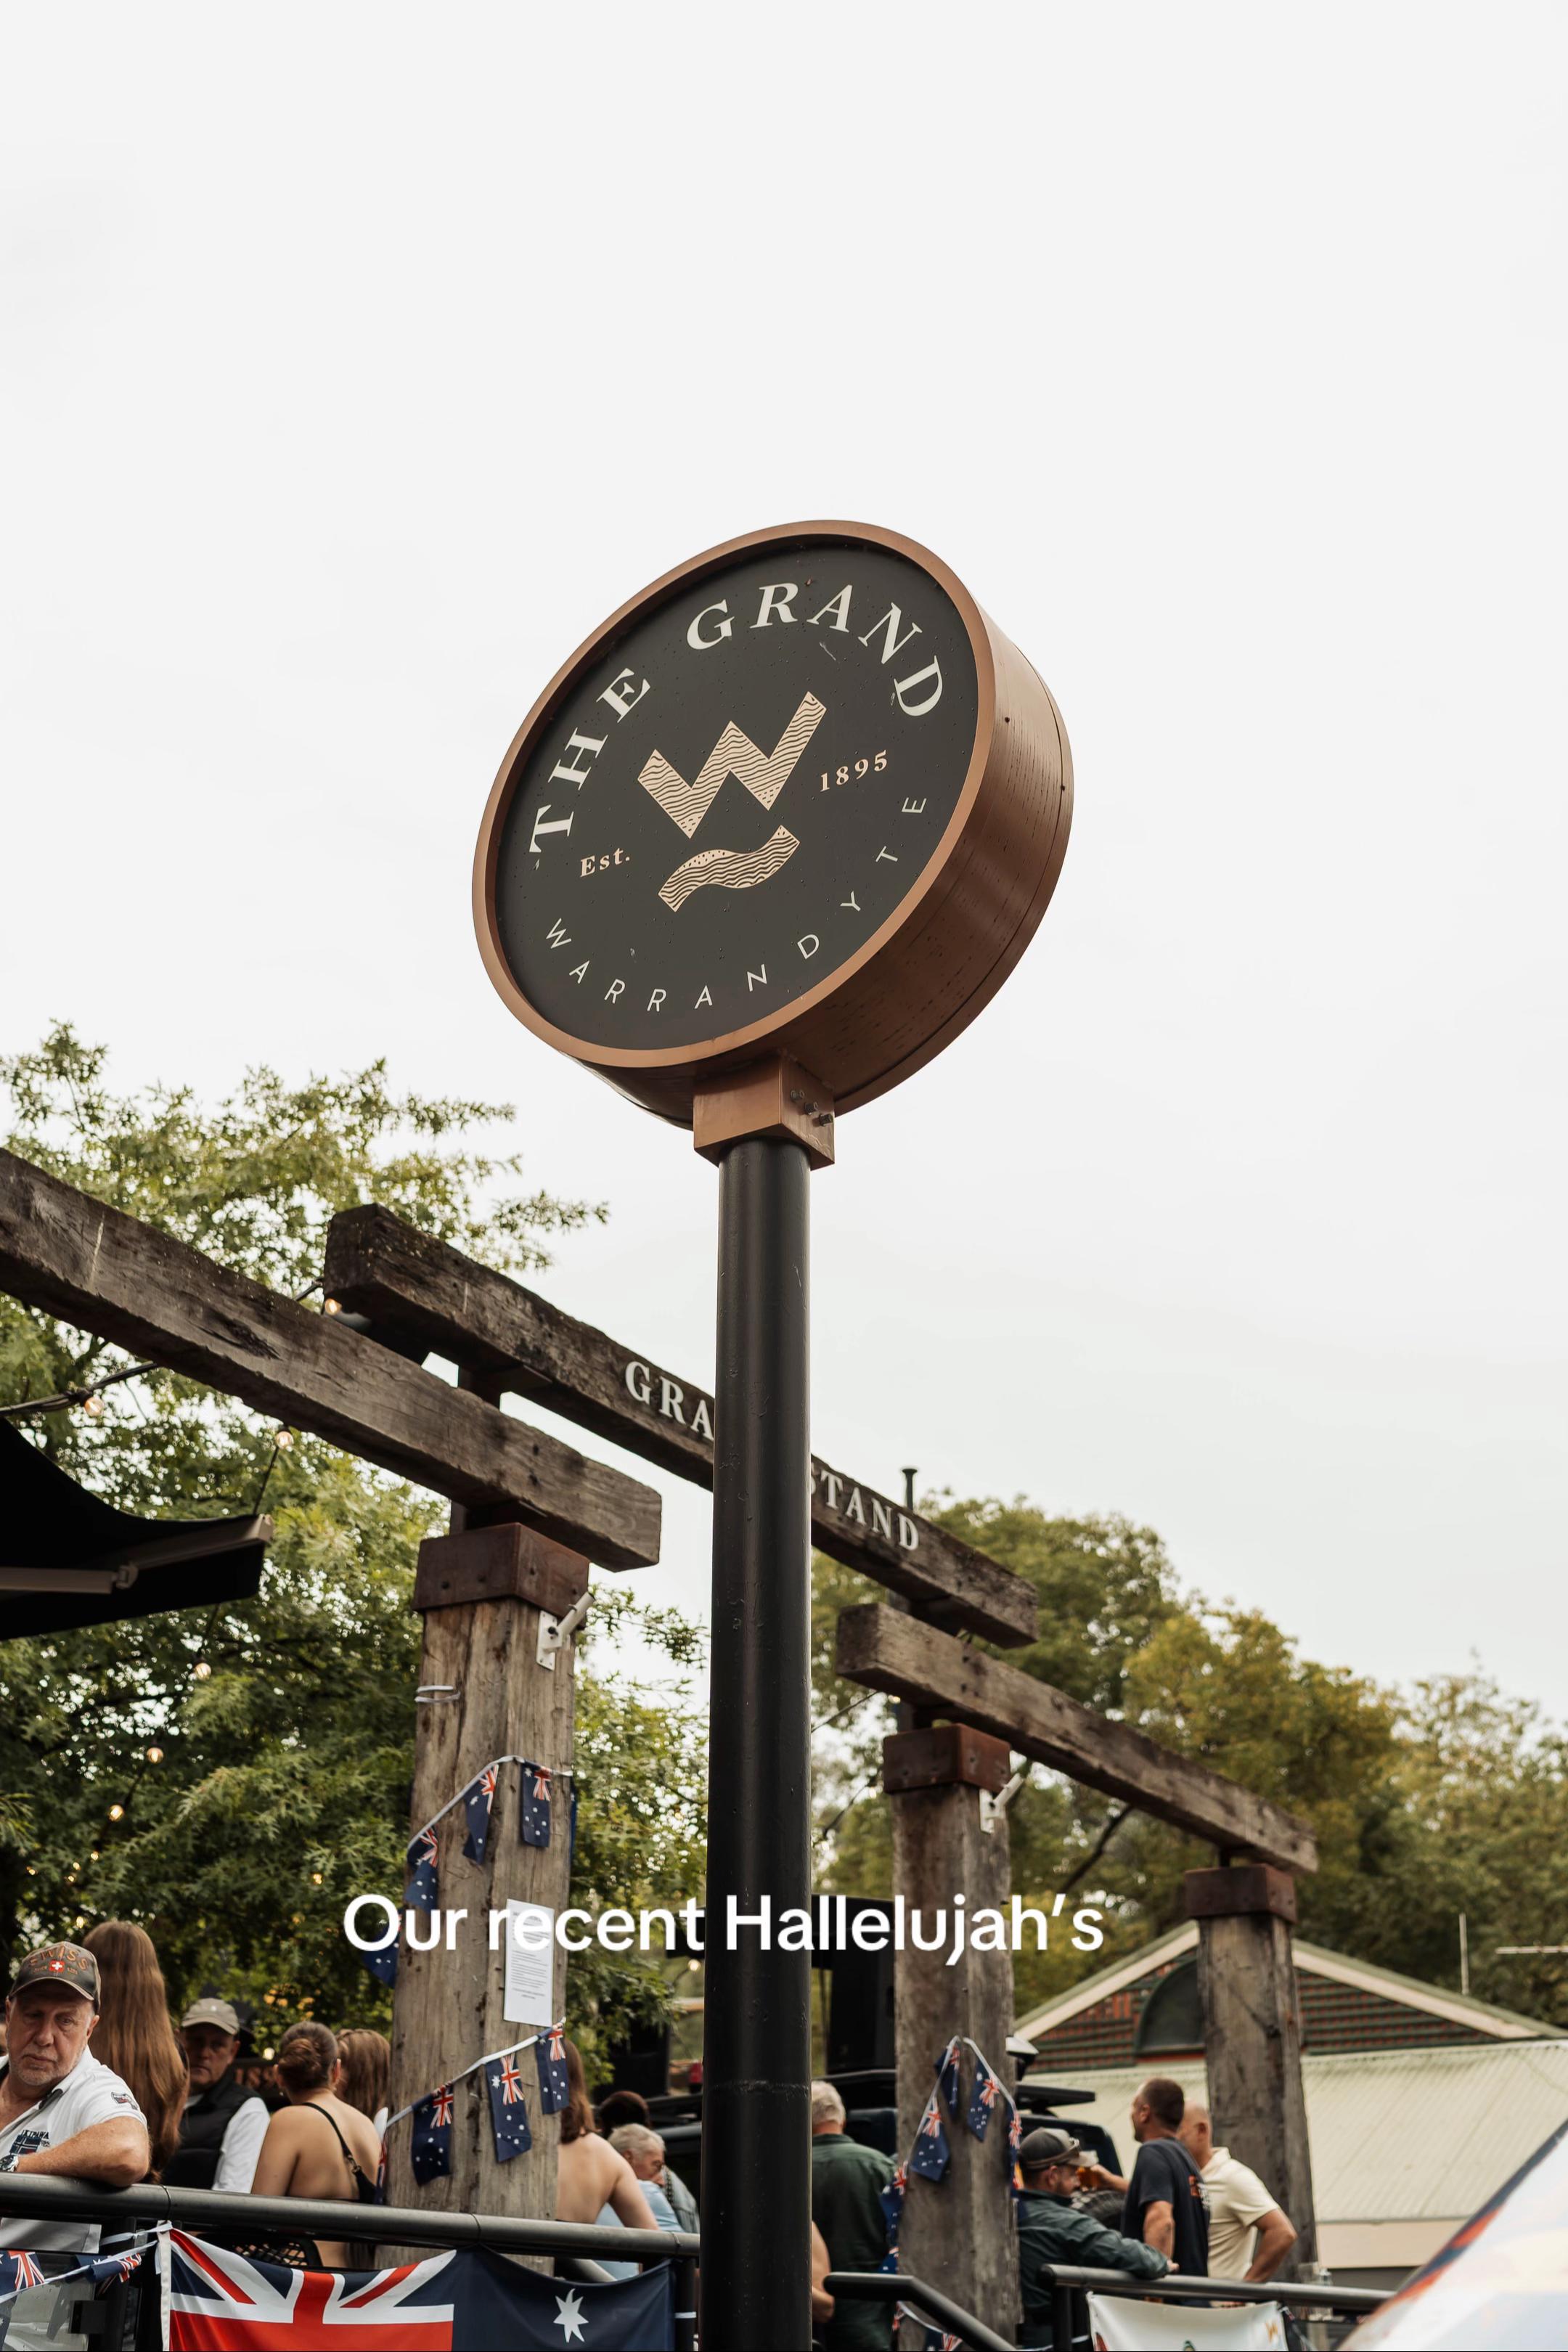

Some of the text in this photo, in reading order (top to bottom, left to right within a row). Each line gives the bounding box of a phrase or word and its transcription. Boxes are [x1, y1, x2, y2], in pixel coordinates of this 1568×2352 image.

[529, 582, 943, 852] THE GRAND
[580, 749, 889, 878] Est. 1895
[546, 797, 927, 1012] WARRANDYTE
[624, 1361, 920, 1551] GRA TAND
